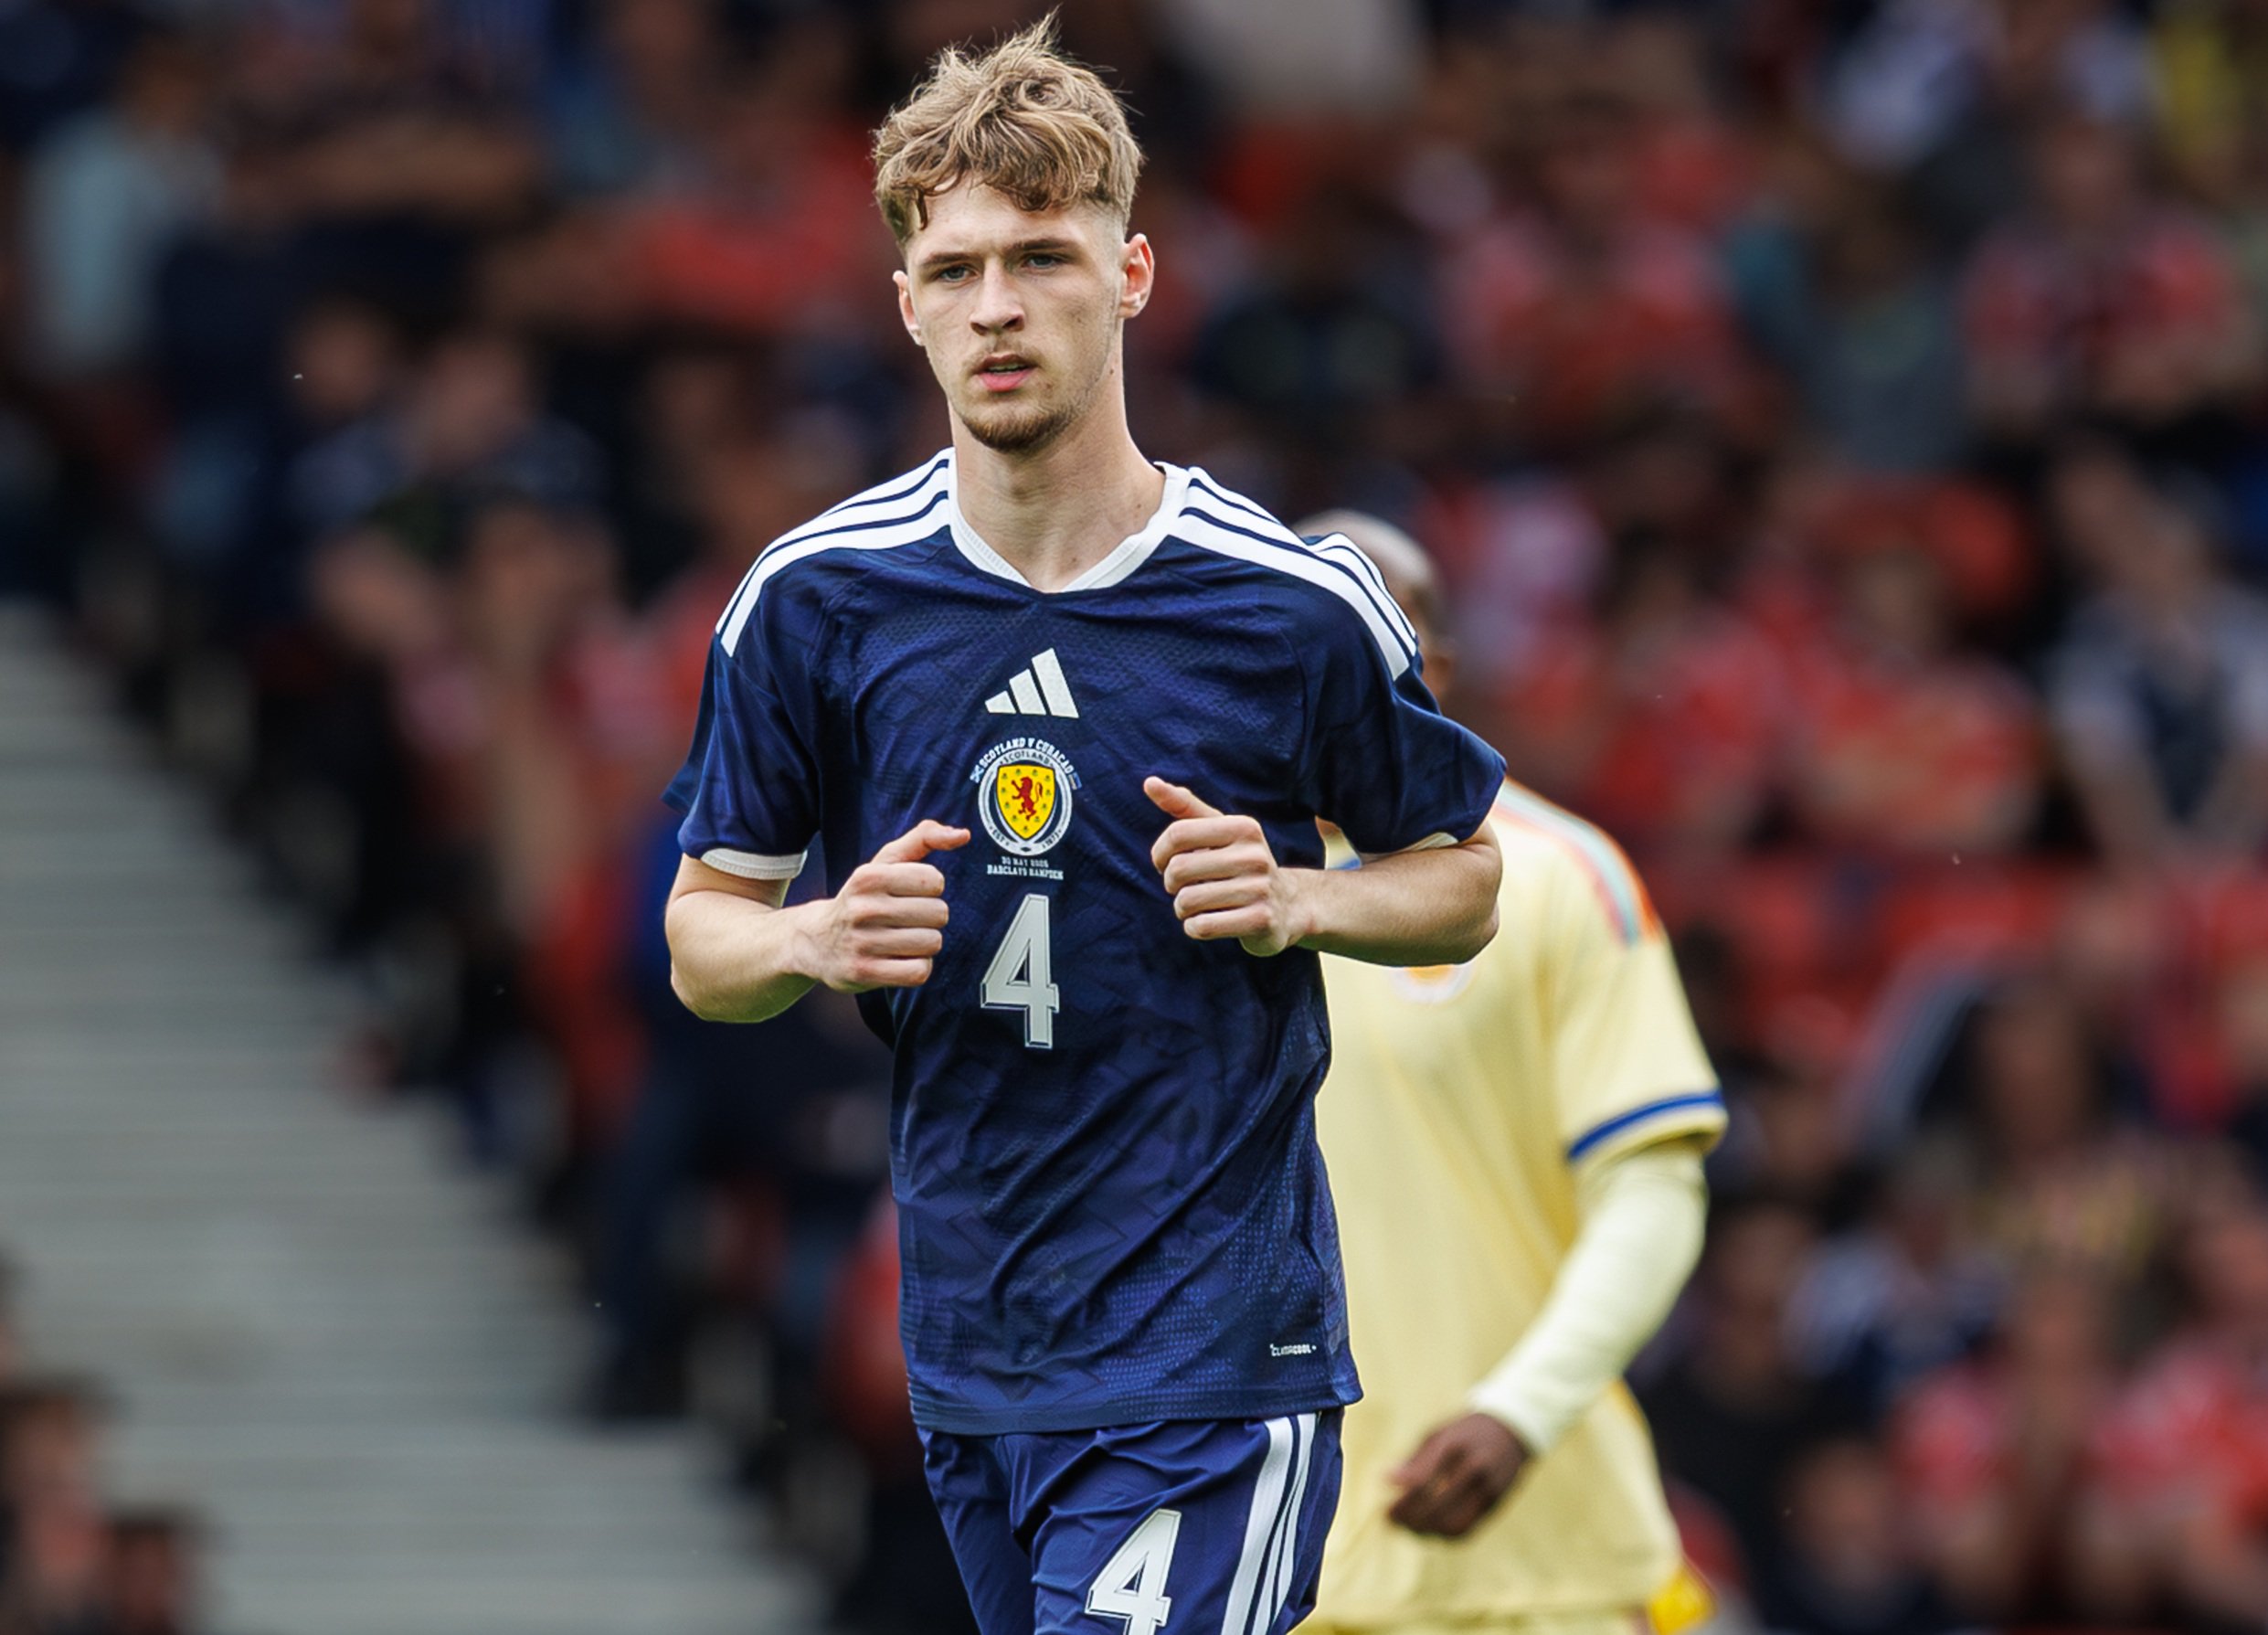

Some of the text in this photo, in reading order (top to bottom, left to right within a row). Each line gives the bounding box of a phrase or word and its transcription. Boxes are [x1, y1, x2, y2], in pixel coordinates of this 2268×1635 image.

[979, 738, 1025, 768] SCOTLAND
[1028, 738, 1035, 748] V
[1004, 749, 1050, 764] SCOTLAND
[987, 864, 1064, 880] BARCLAYS HAMPDEN
[1012, 857, 1028, 866] MAY
[980, 893, 1060, 1049] 4
[1084, 1508, 1182, 1635] 4
